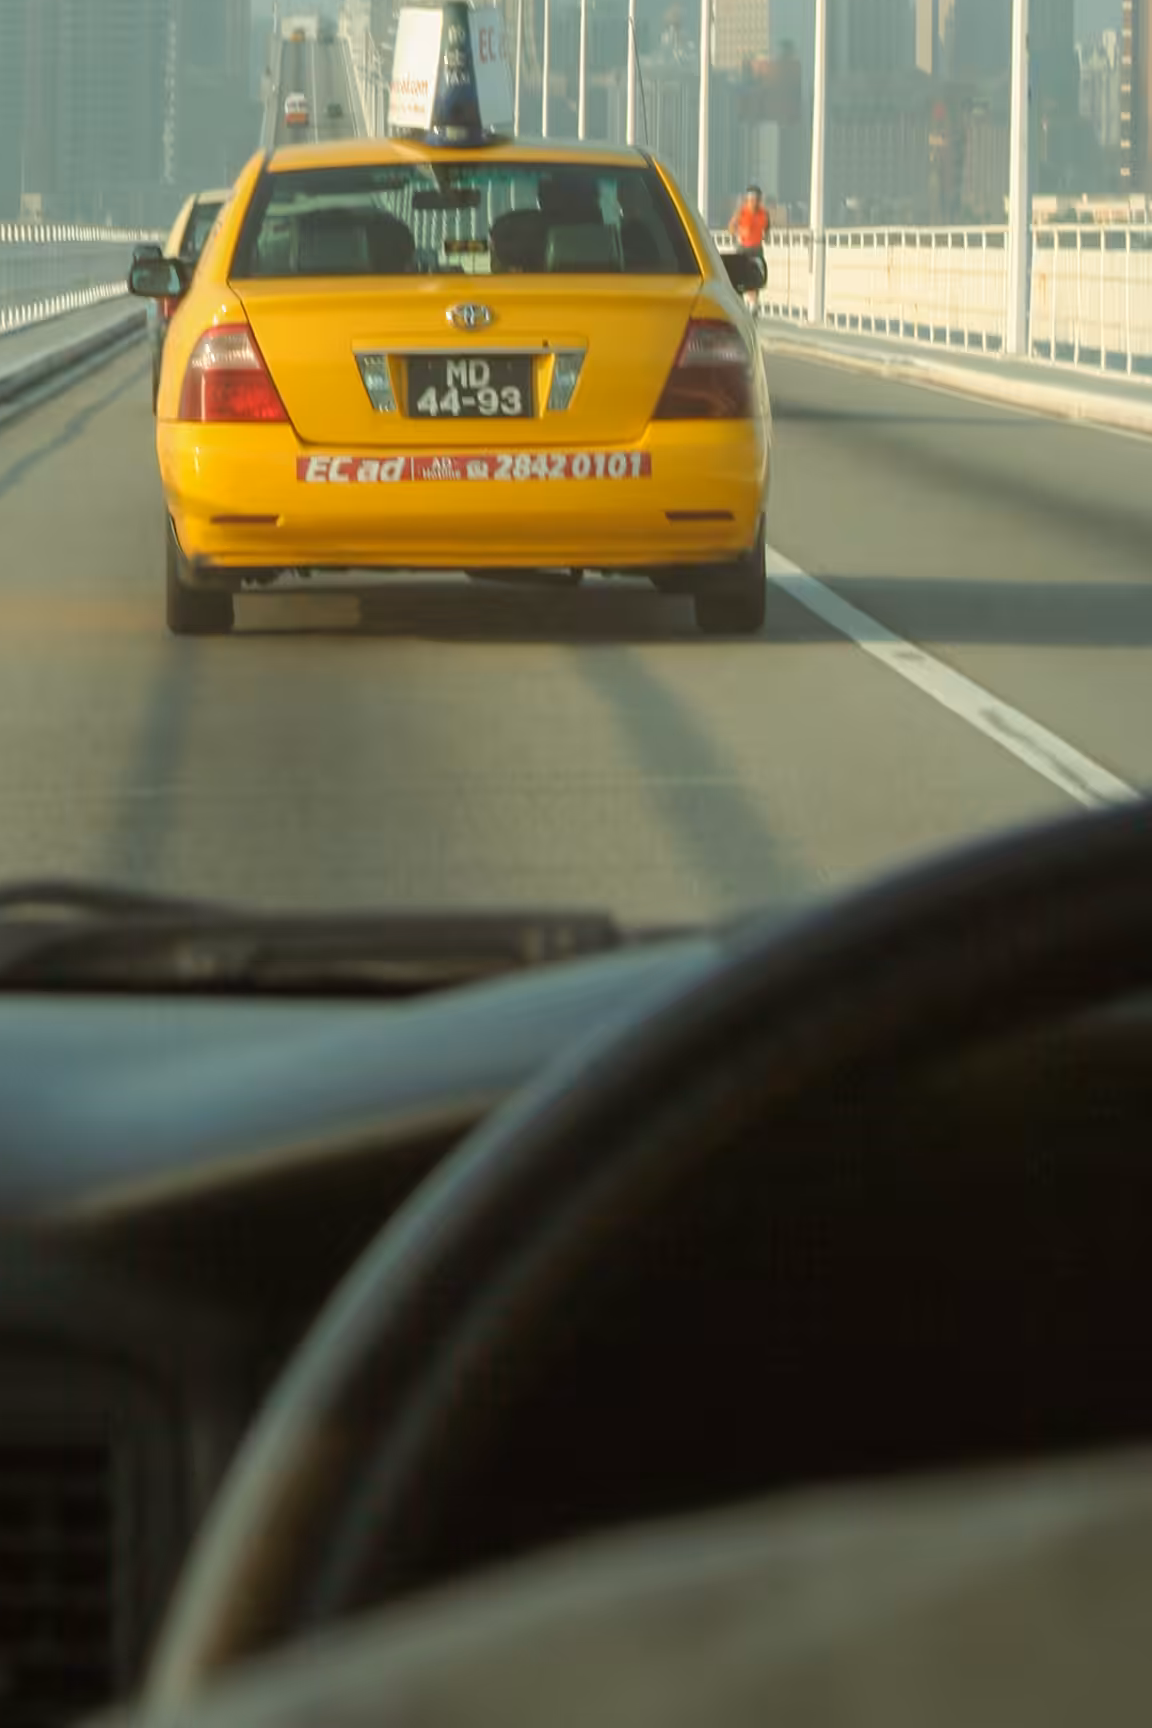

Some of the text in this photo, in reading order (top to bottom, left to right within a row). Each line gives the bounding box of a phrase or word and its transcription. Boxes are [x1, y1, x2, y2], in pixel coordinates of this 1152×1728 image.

[446, 359, 490, 387] MD
[416, 387, 523, 417] 44-93
[305, 456, 405, 482] EC ad
